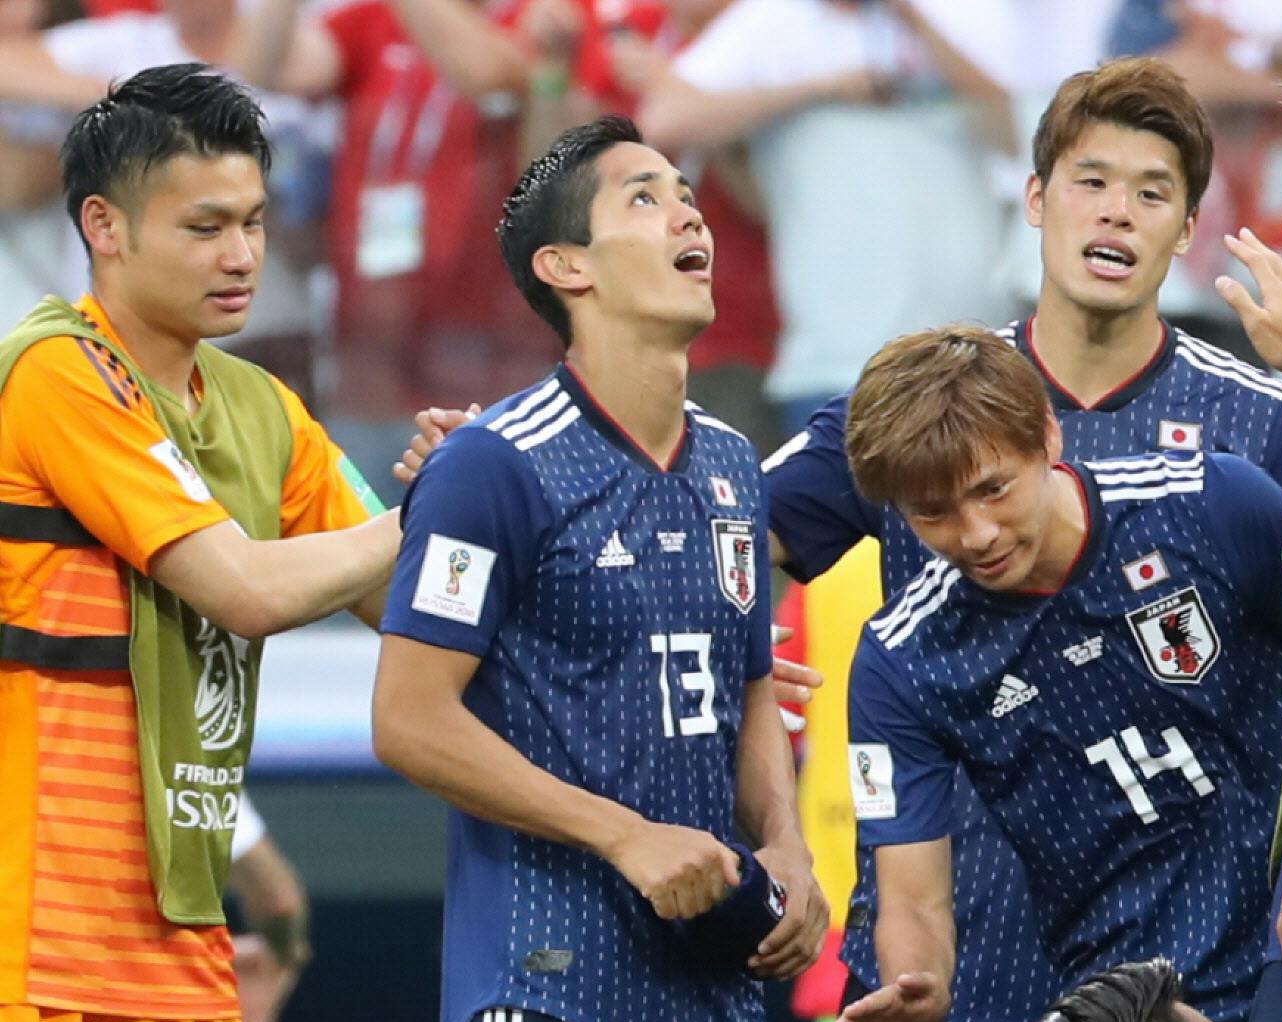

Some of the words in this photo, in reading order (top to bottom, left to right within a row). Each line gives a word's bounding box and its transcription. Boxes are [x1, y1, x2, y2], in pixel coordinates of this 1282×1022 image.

[596, 553, 637, 569] adidas
[649, 632, 719, 739] 13
[991, 684, 1040, 718] adidas
[1083, 724, 1216, 826] 14
